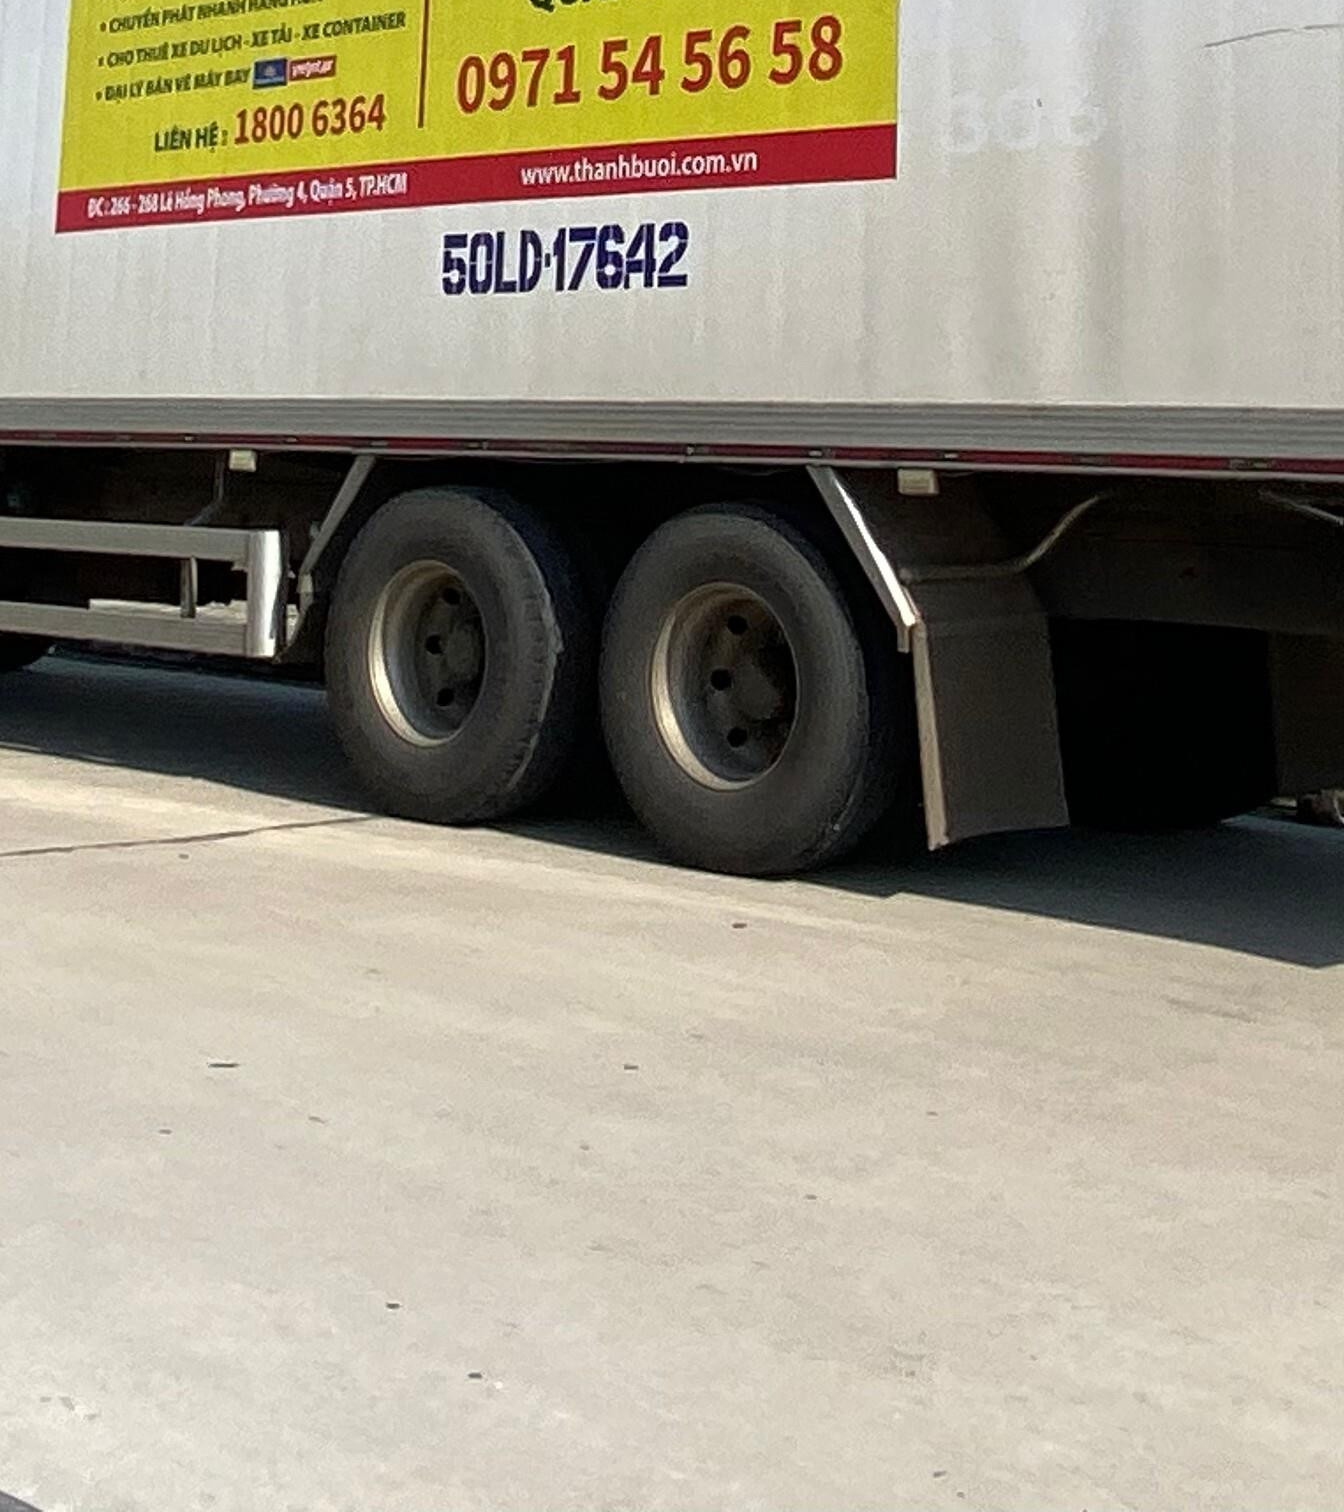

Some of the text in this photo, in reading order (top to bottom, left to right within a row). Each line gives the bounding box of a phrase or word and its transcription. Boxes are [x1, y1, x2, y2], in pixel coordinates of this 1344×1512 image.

[191, 41, 209, 57] DU
[250, 31, 268, 48] XE
[302, 24, 320, 39] XE
[323, 11, 406, 38] CONTAINER
[457, 14, 843, 113] 0971 54 56 58
[155, 125, 191, 152] LIÊN
[234, 102, 304, 145] 1800
[312, 93, 385, 137] 6364
[345, 176, 357, 200] 5,
[520, 149, 758, 185] www.thanhbuoi.com.vn
